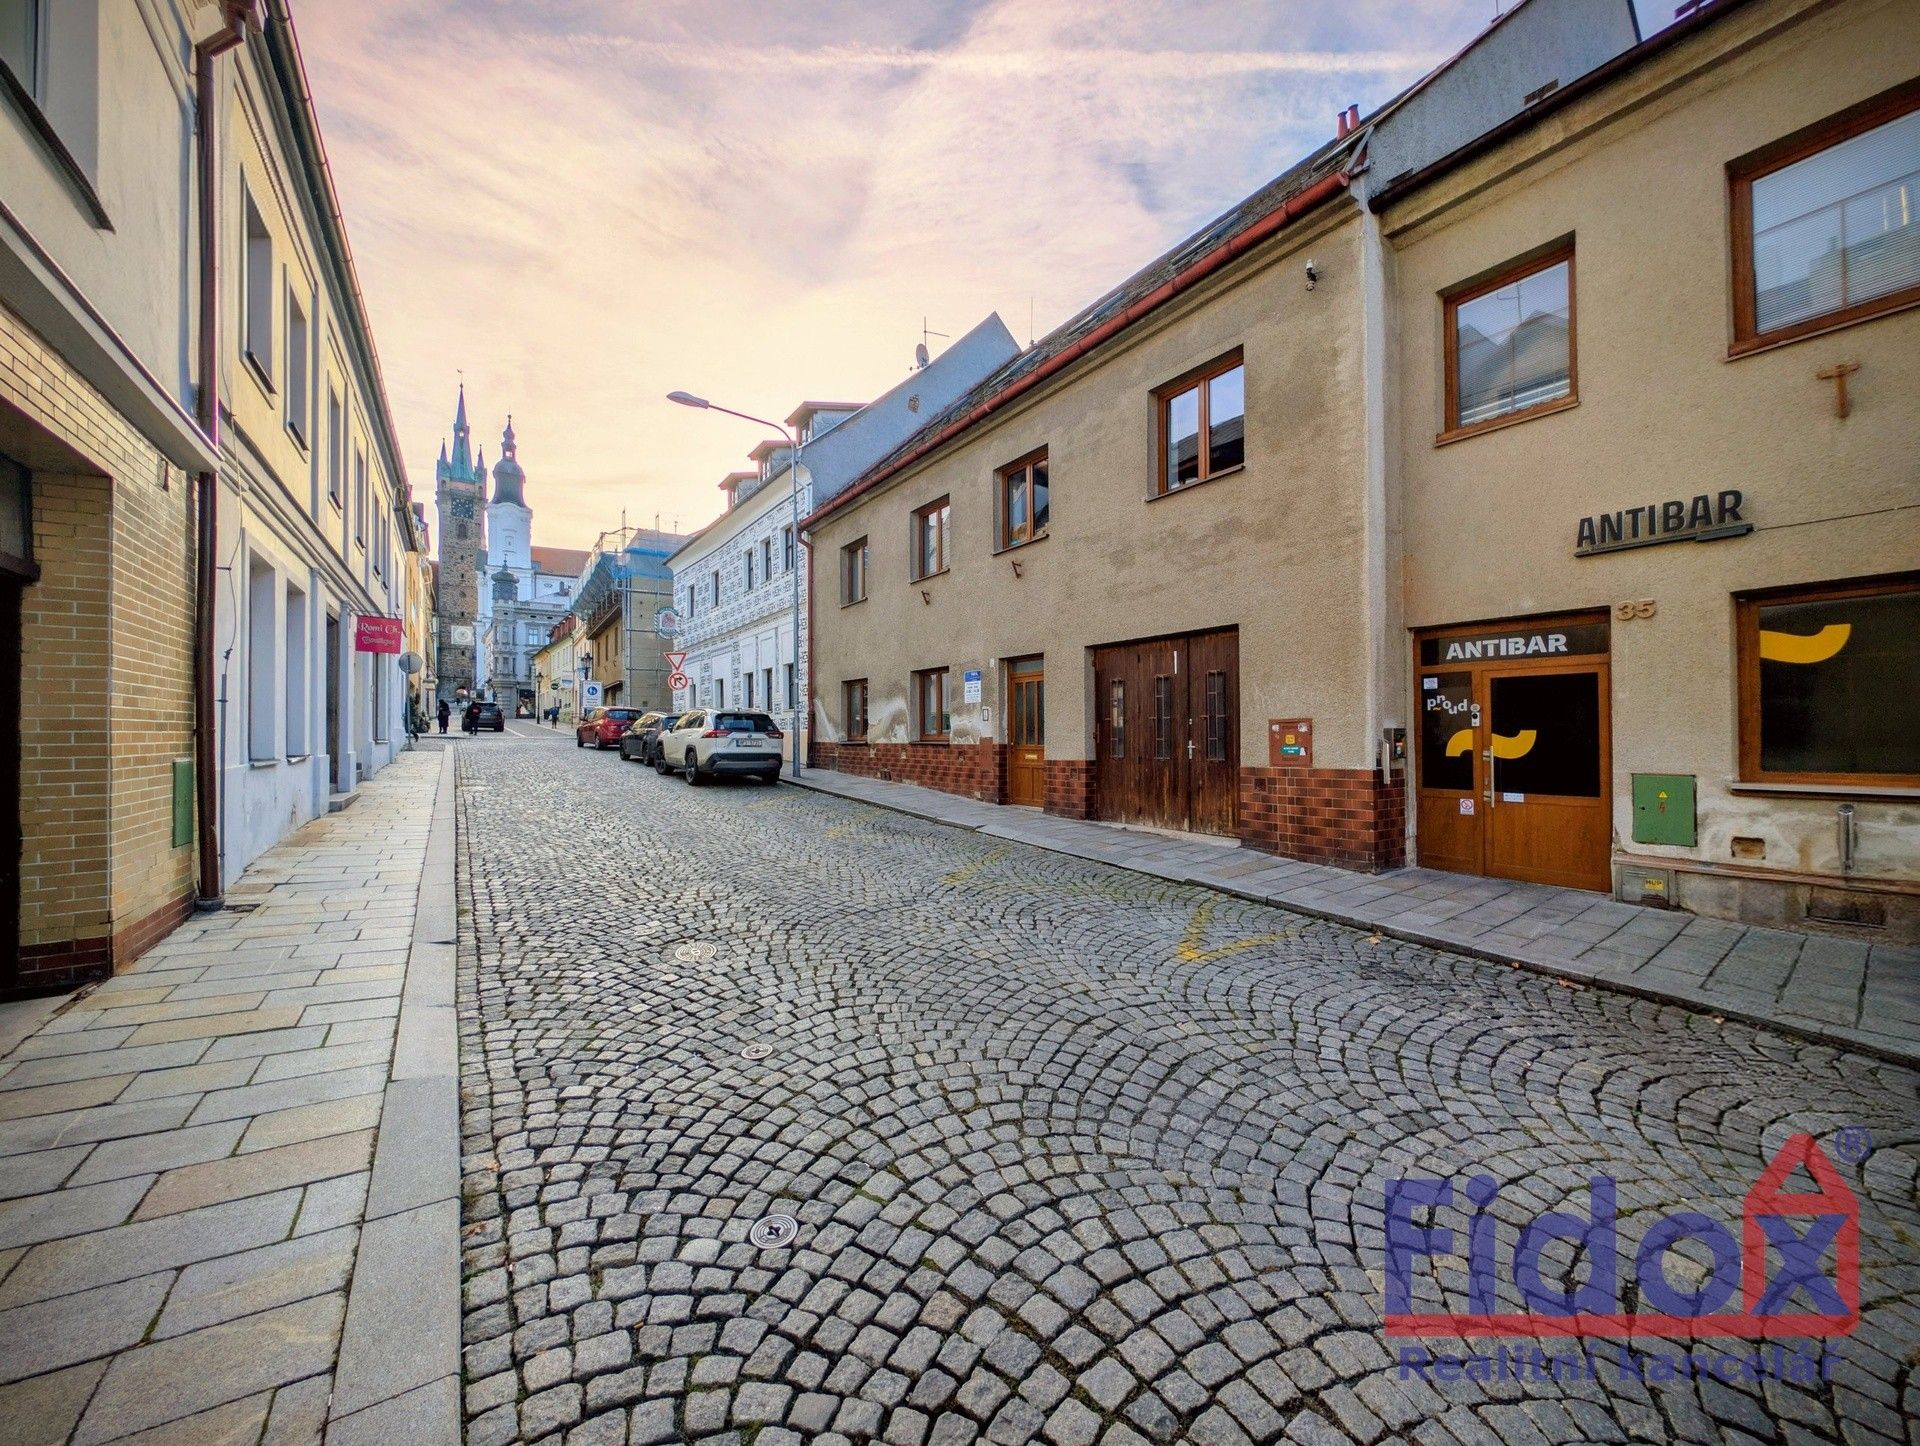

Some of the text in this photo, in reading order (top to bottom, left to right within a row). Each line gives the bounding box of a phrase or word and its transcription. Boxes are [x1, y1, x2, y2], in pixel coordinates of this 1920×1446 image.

[1576, 489, 1743, 548] ANTIBAR
[1615, 599, 1656, 621] 35
[1446, 633, 1568, 660] ANTIBAR
[1427, 694, 1468, 715] proud
